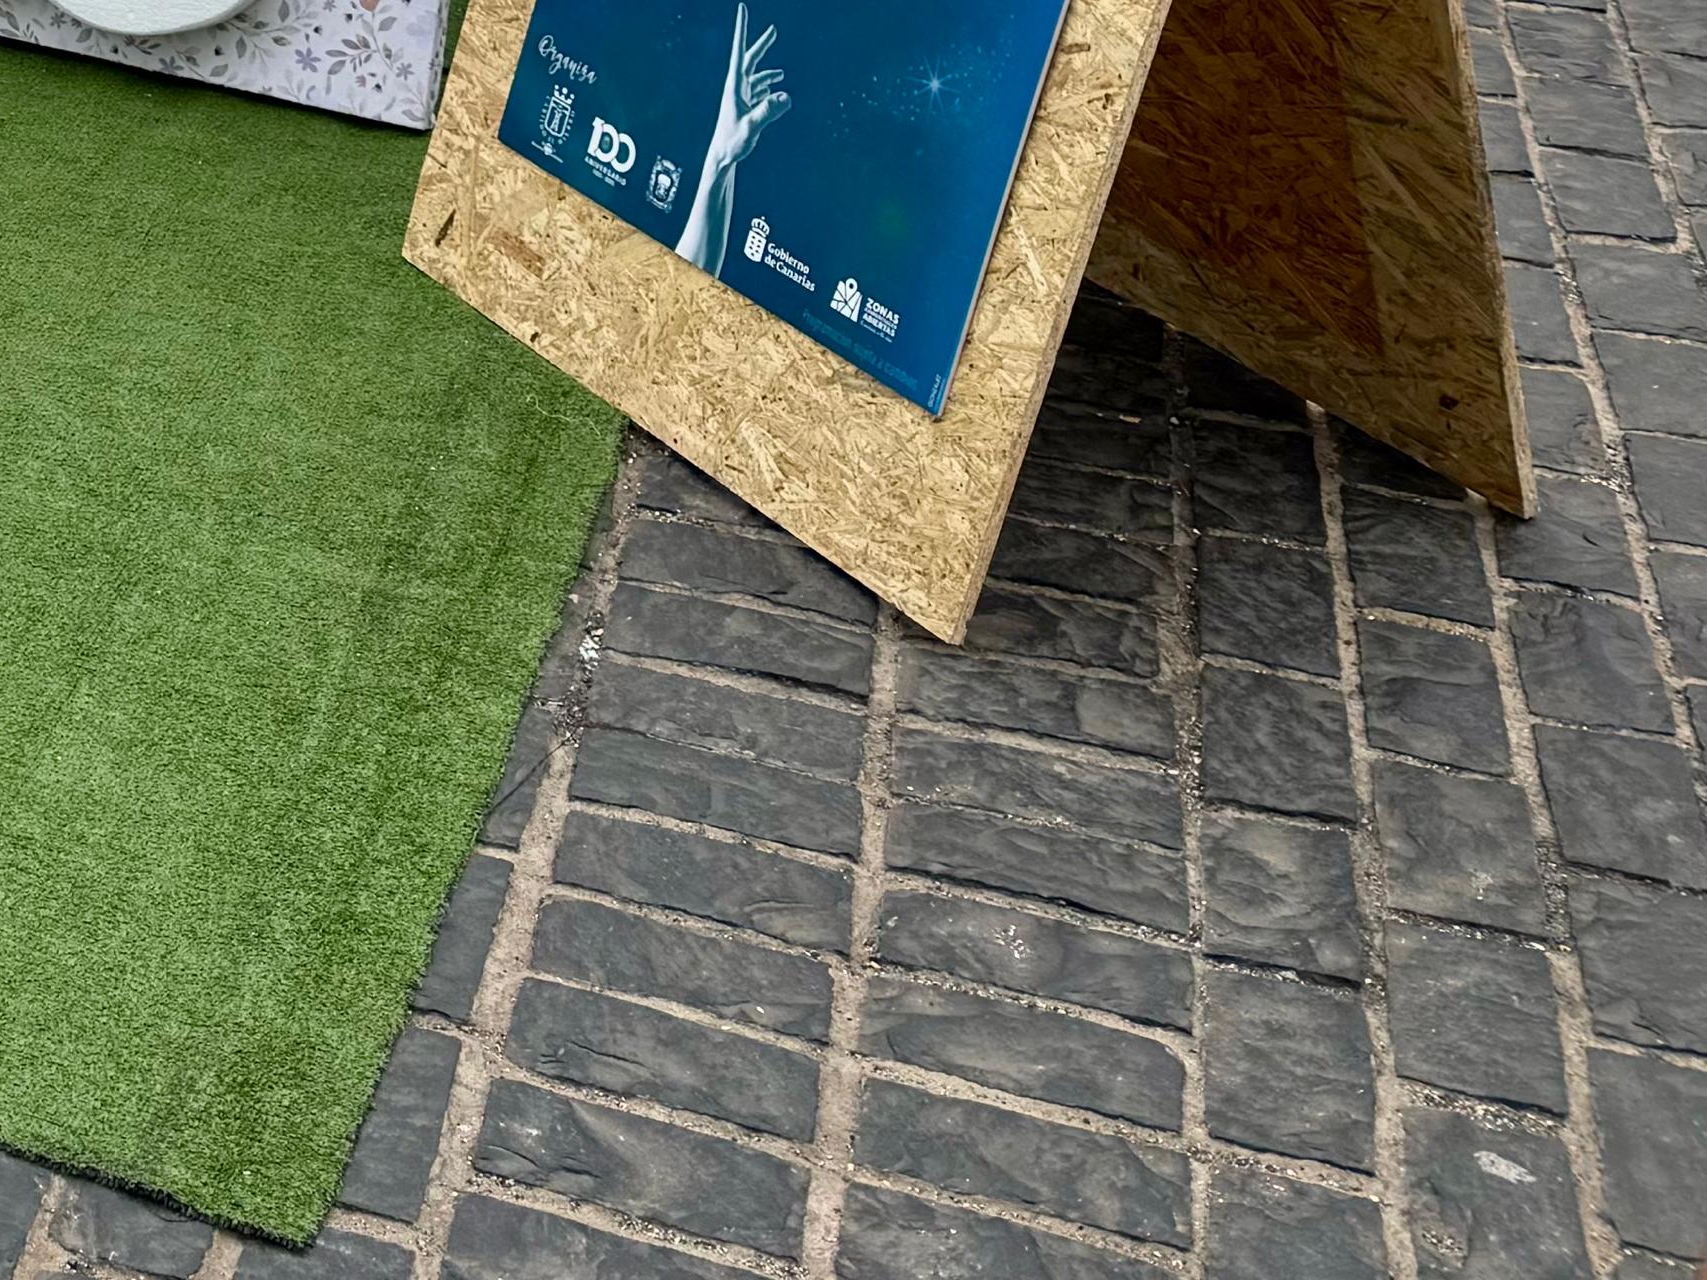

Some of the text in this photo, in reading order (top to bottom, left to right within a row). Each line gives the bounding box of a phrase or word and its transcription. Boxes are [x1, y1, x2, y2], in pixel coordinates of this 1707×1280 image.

[538, 34, 598, 84] Organiza
[764, 254, 816, 292] de Canarias
[767, 241, 810, 275] Gobierno
[866, 297, 900, 325] ZONAS
